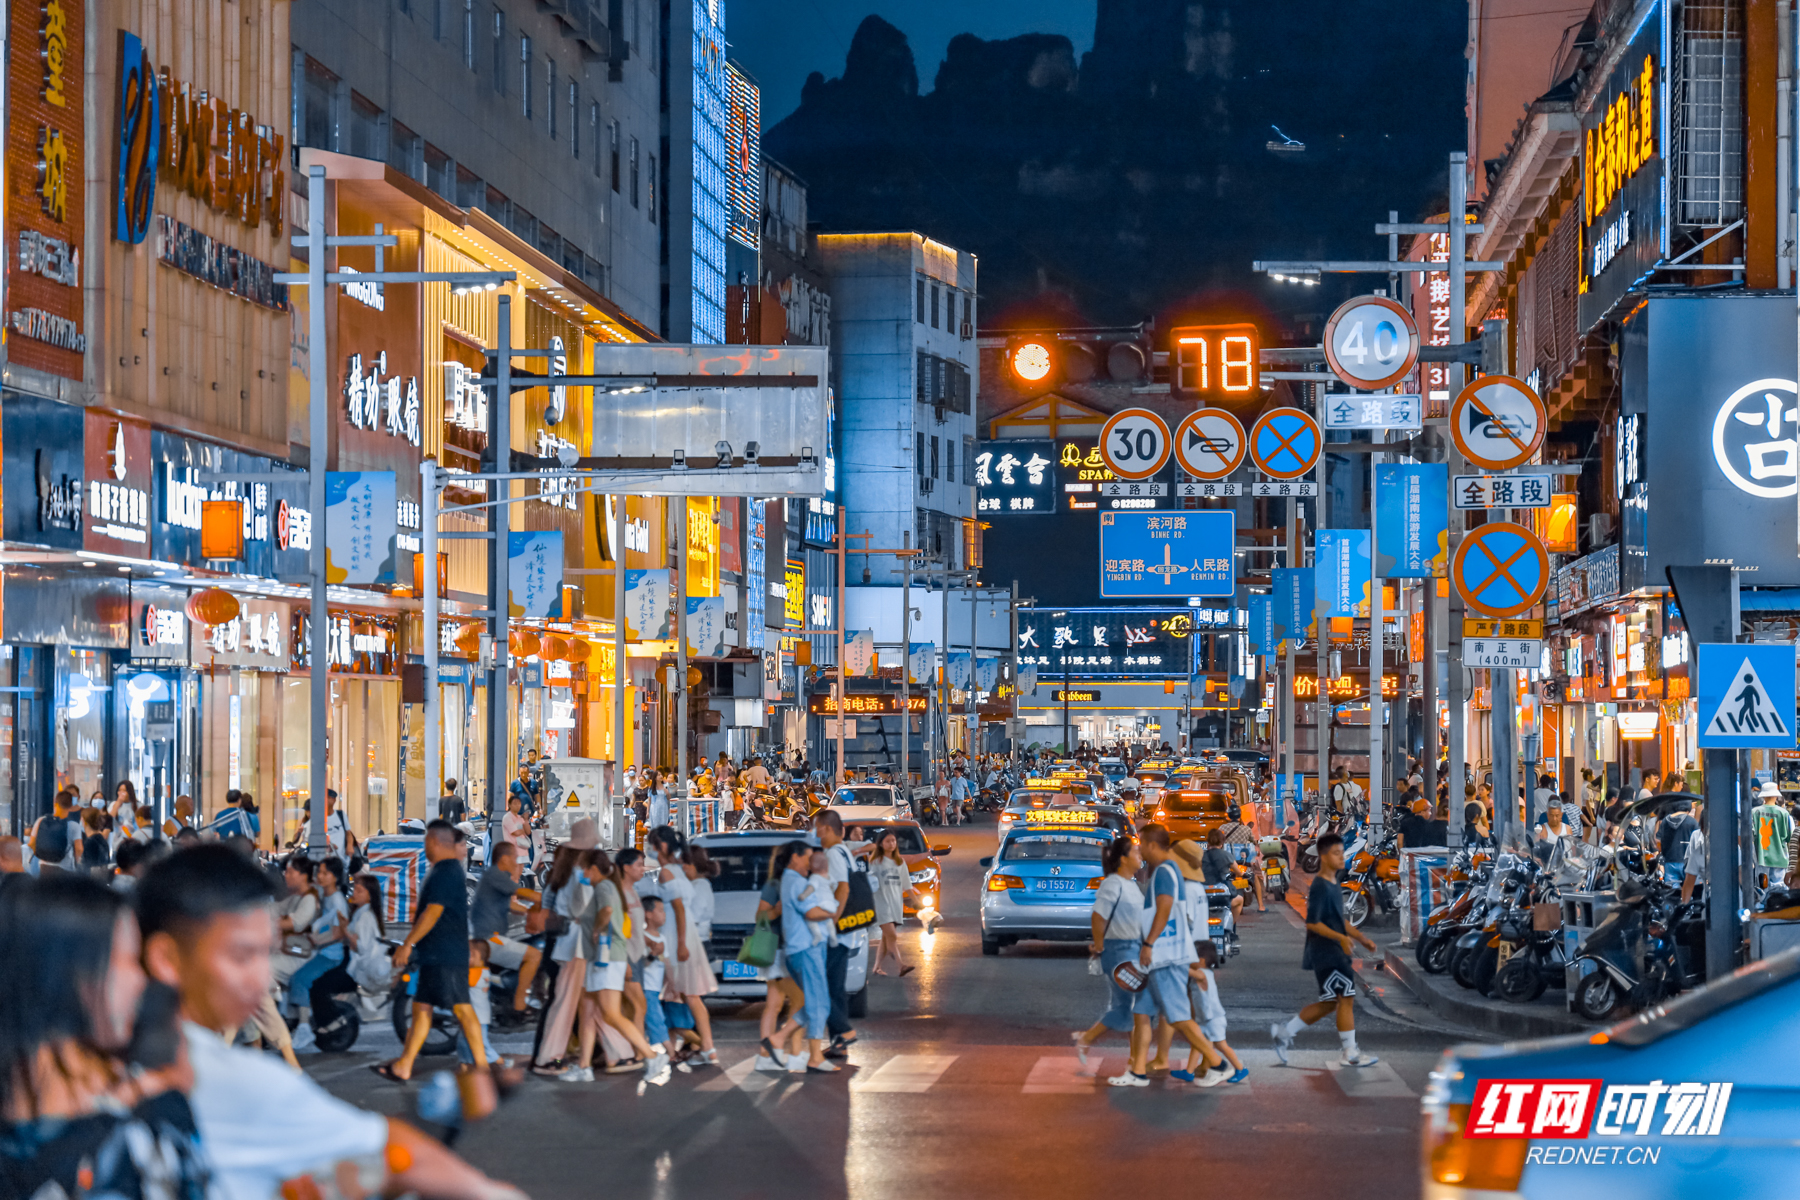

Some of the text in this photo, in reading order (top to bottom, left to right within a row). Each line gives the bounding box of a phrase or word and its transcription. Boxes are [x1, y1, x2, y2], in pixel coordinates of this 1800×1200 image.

[1340, 320, 1399, 365] 40
[1178, 336, 1253, 391] 78
[348, 352, 421, 447] 精功眼镜
[1332, 399, 1411, 424] 全路段
[1113, 428, 1158, 460] 30
[1110, 484, 1161, 495] 全路段
[1184, 484, 1235, 496] 全路段
[1261, 484, 1312, 496] 全路段
[1462, 479, 1543, 505] 全路段
[978, 498, 1034, 510] 台球 棋牌
[1147, 516, 1187, 530] 滨河路
[1409, 475, 1420, 570] 首届湖南旅游发展大会
[1105, 559, 1145, 572] 迎宾路
[1190, 558, 1230, 572] 人民路
[1107, 573, 1145, 581] YINGBIN RD.
[1341, 538, 1350, 612] 首届湖南旅游发展大会
[1293, 575, 1301, 634] 首届湖南旅游发展大会
[1475, 642, 1530, 654] 南正街
[1479, 656, 1527, 666] (400m)
[1026, 811, 1096, 823] 文明驾驶安全行车
[1049, 880, 1075, 890] T5572
